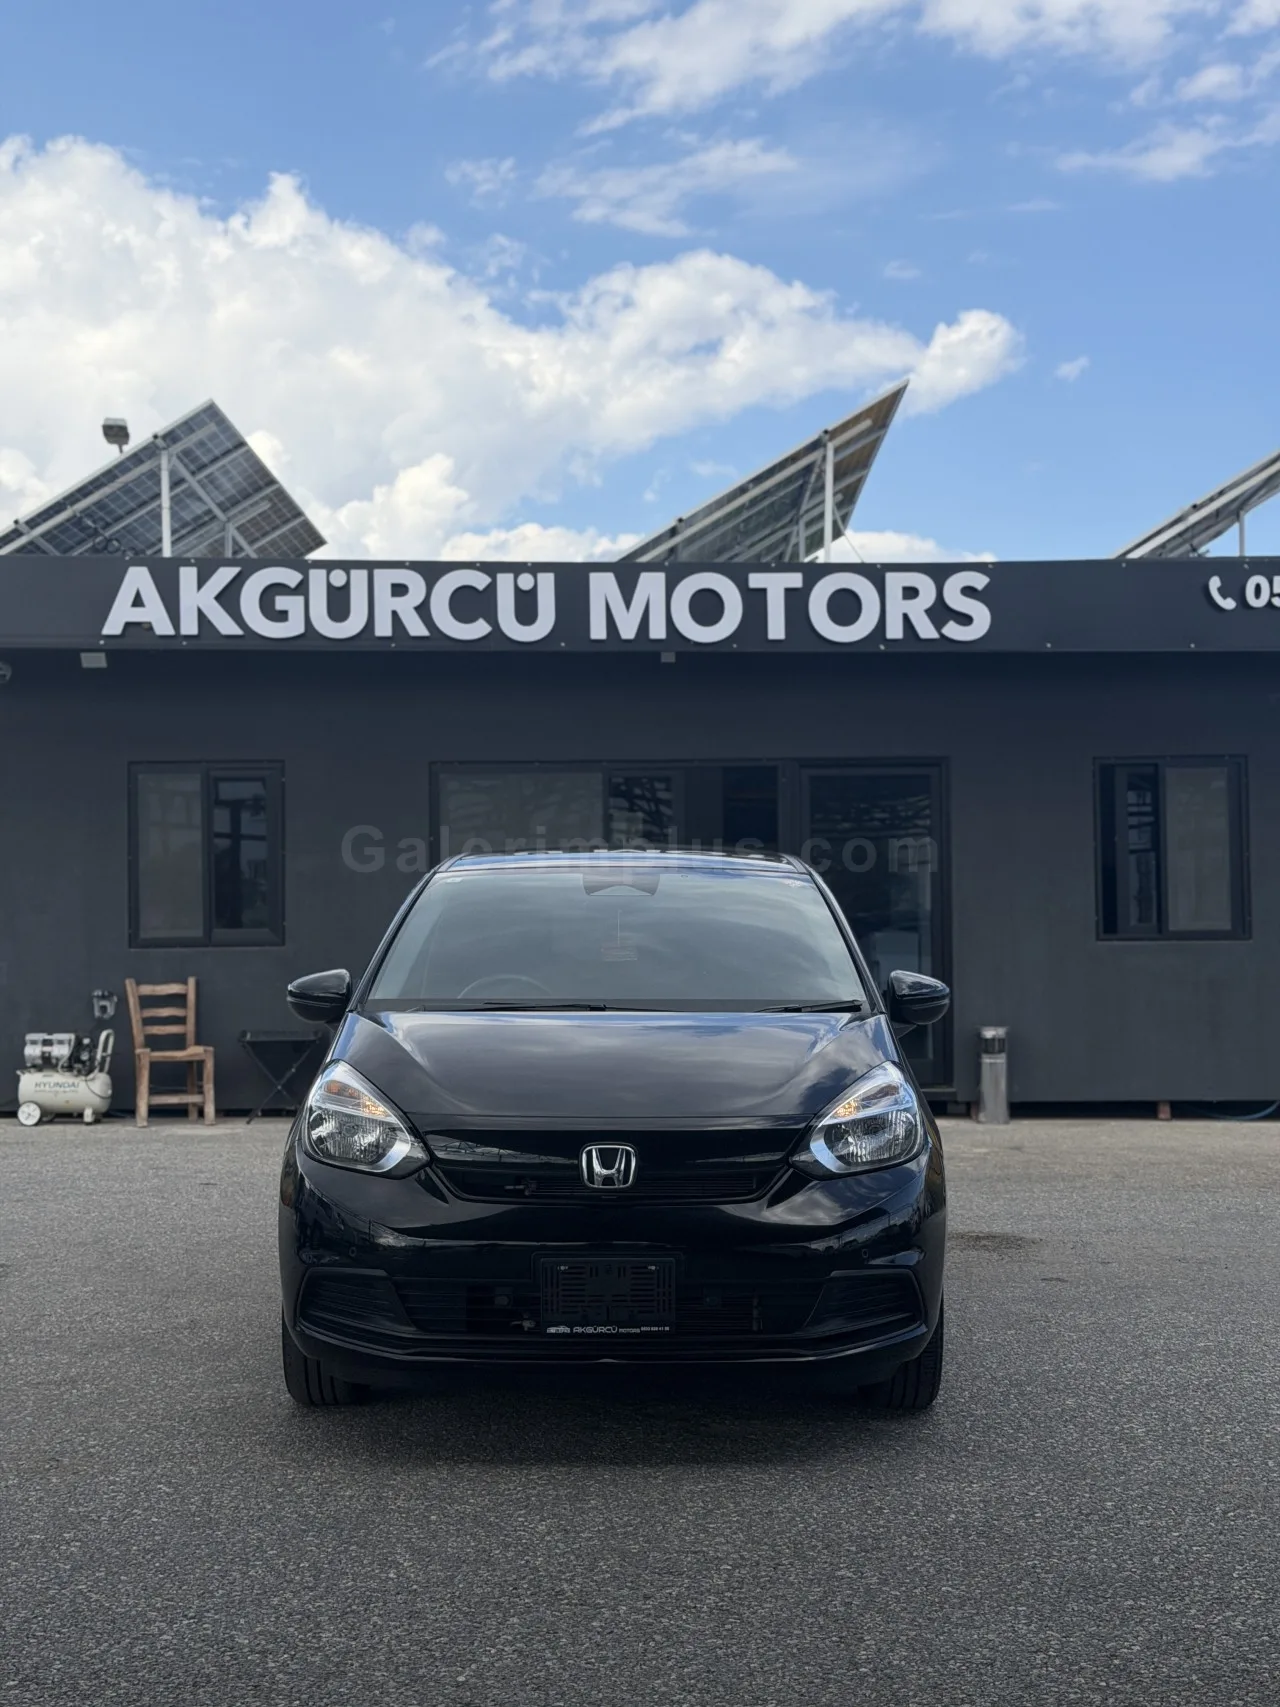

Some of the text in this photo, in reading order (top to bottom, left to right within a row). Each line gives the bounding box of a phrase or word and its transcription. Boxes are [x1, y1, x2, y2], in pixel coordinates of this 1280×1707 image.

[101, 566, 992, 643] AKGÜRCÜ MOTORS
[34, 1080, 80, 1089] HYUNDAI
